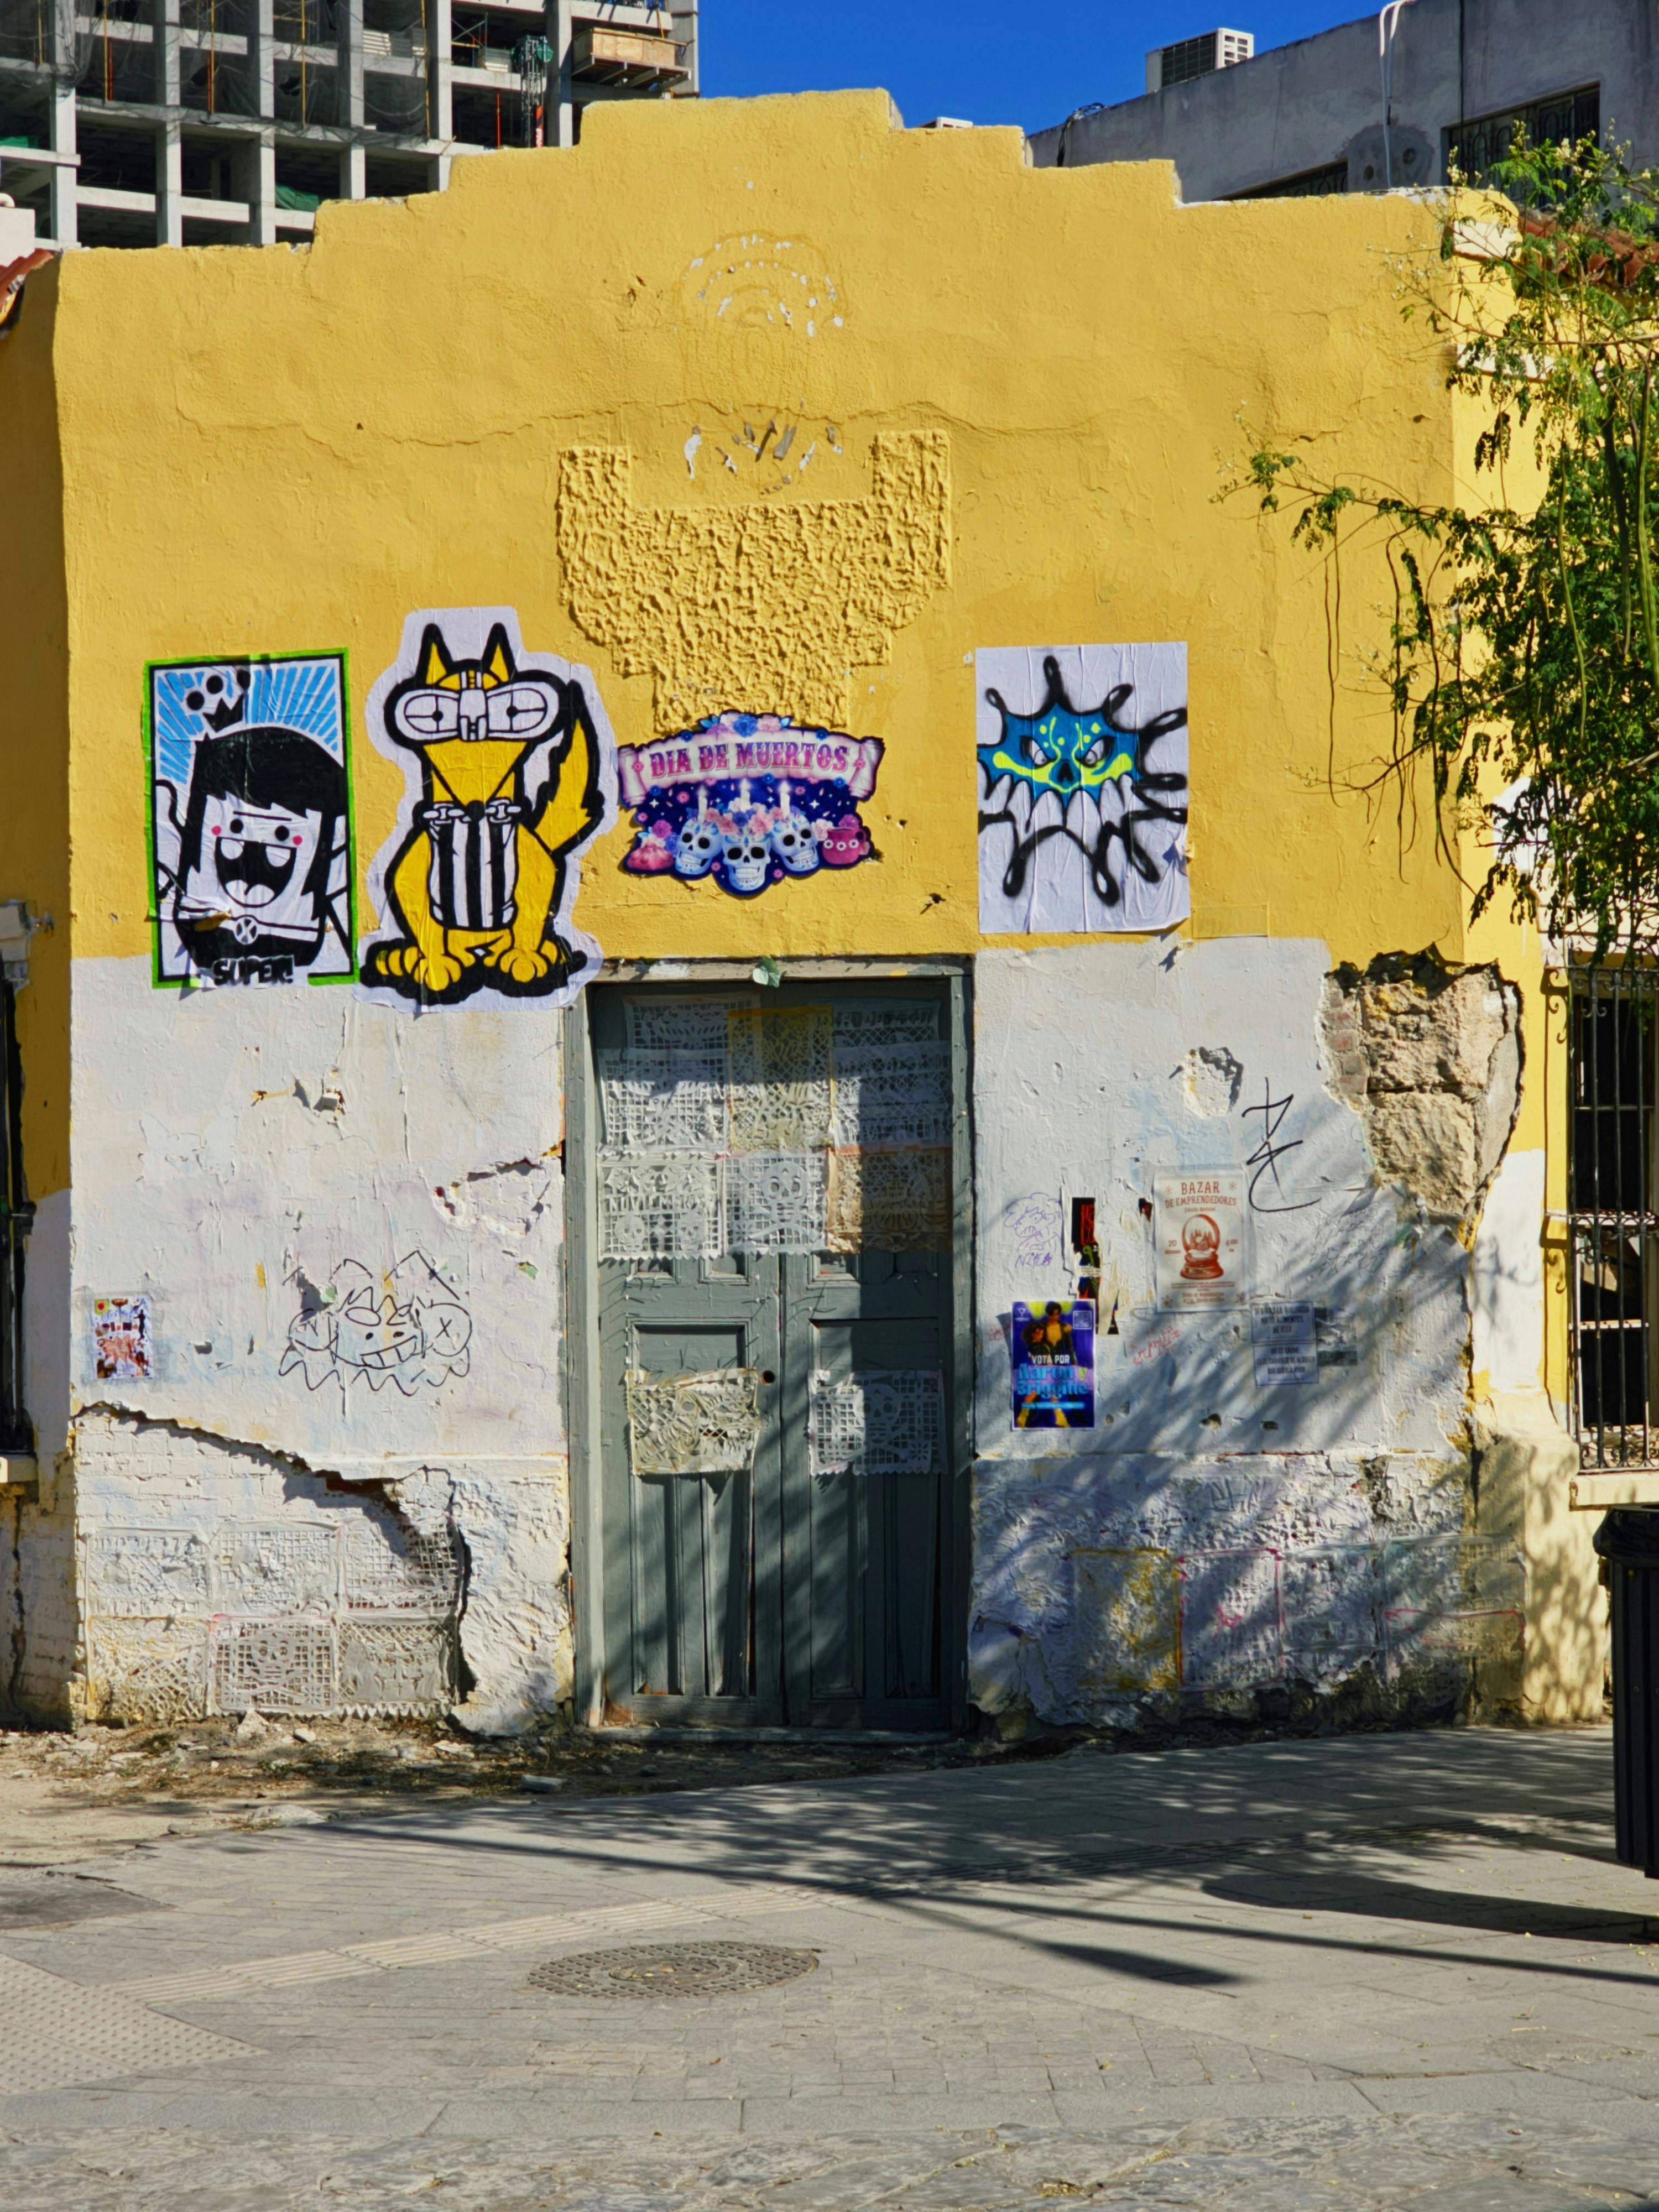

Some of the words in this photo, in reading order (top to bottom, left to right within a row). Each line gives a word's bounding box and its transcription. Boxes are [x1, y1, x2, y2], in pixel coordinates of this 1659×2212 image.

[649, 745, 692, 778] DIA
[698, 743, 730, 771] DE
[735, 740, 849, 772] MUERTOS
[212, 954, 295, 987] SUPER!
[1181, 1181, 1220, 1194] BAZAR
[1165, 1199, 1176, 1208] DE
[1176, 1195, 1237, 1207] EMPRENDEDORES
[1032, 1355, 1052, 1364] VOTA
[1055, 1355, 1070, 1364] POR
[1017, 1363, 1074, 1379] Aaron
